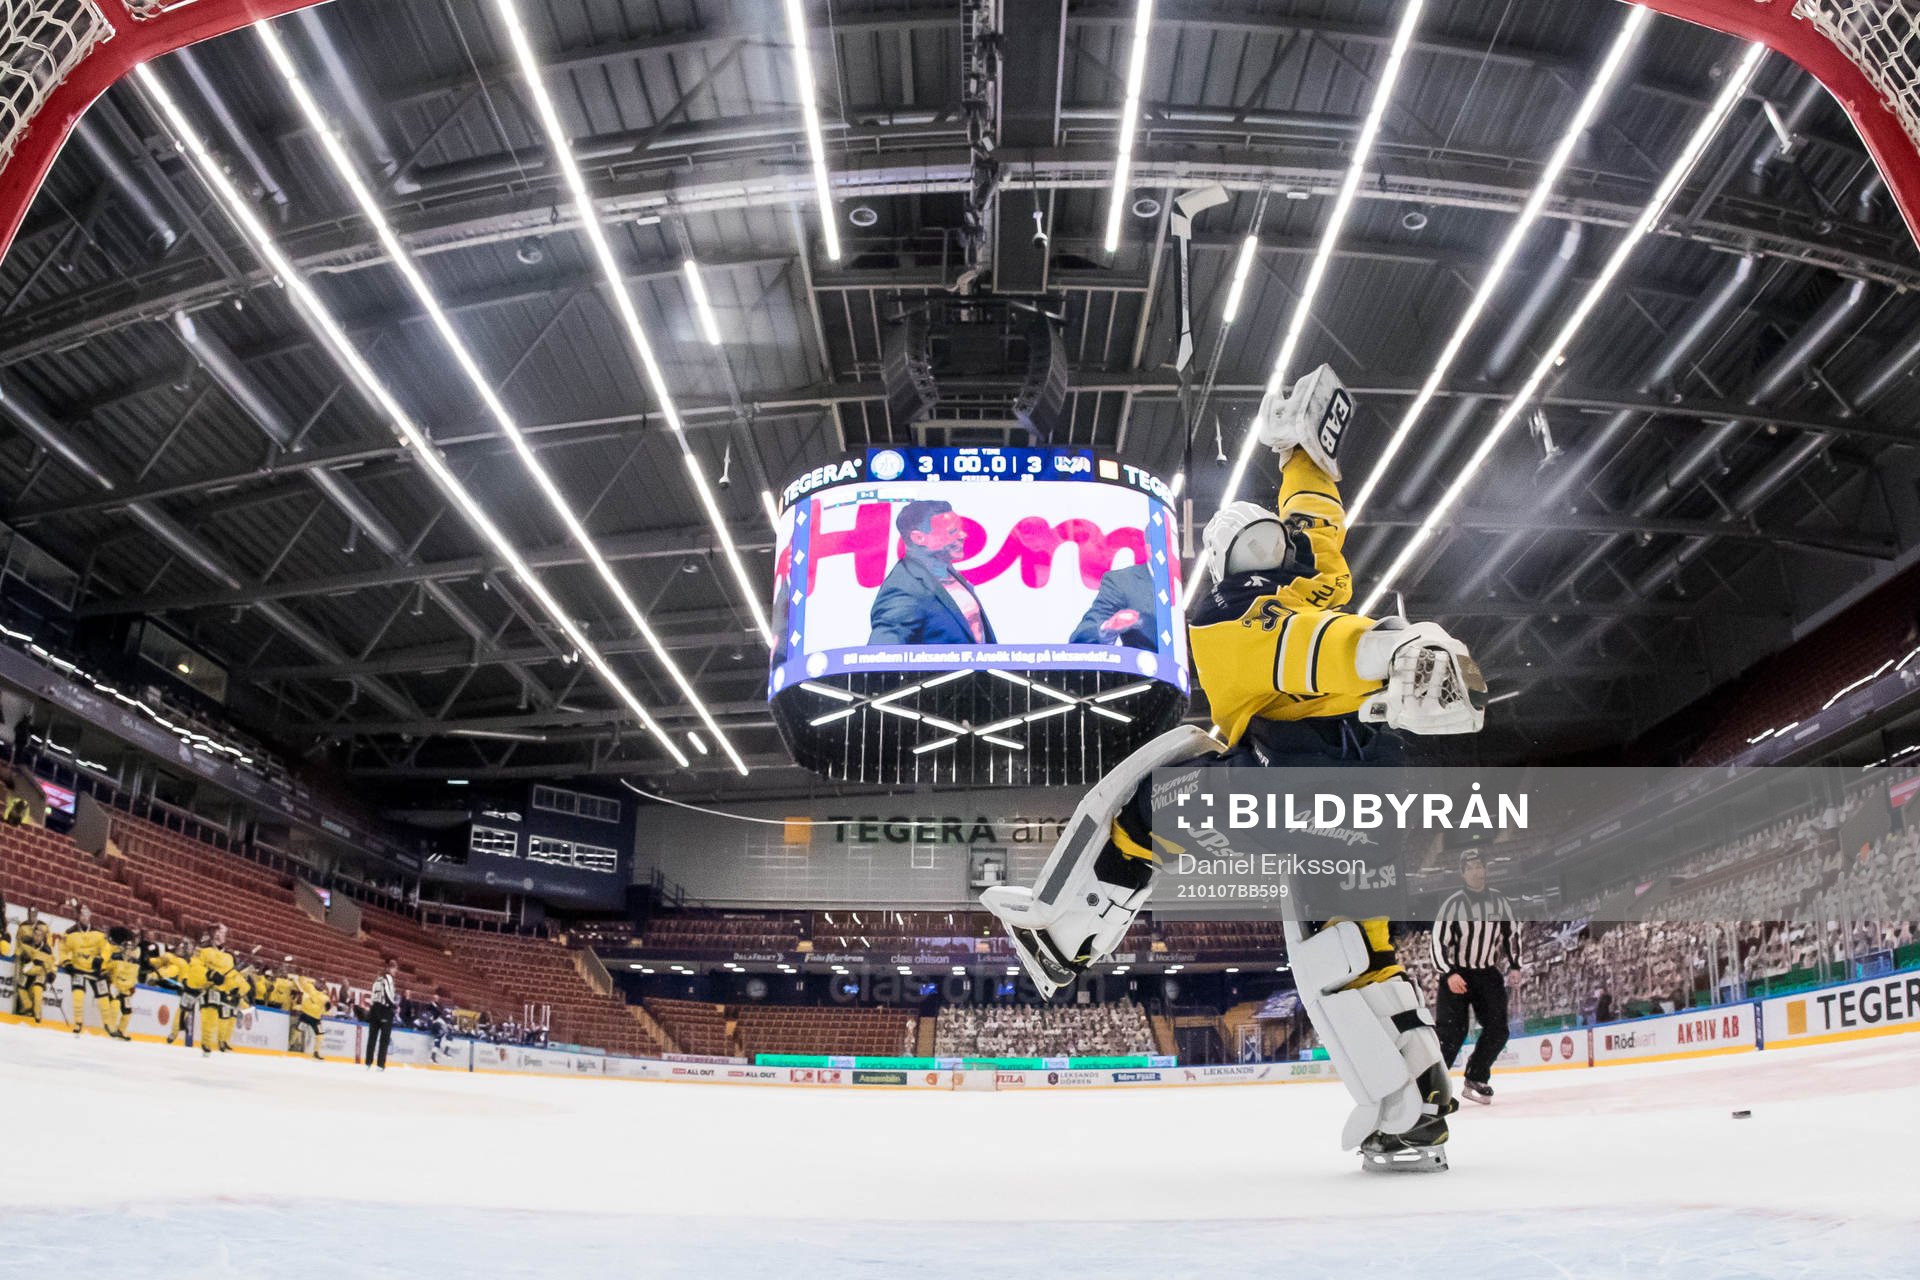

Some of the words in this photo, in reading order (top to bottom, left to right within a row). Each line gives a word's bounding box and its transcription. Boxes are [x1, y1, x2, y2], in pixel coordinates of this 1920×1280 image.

[918, 456, 934, 473] 3
[953, 456, 1007, 473] 00.0
[1027, 456, 1042, 473] 3
[784, 459, 859, 507] TEGERA
[1123, 464, 1176, 512] TEGE
[827, 816, 998, 844] TEGERA
[890, 953, 913, 964] clas
[914, 953, 950, 964] ohlson
[1723, 1015, 1739, 1039] AB
